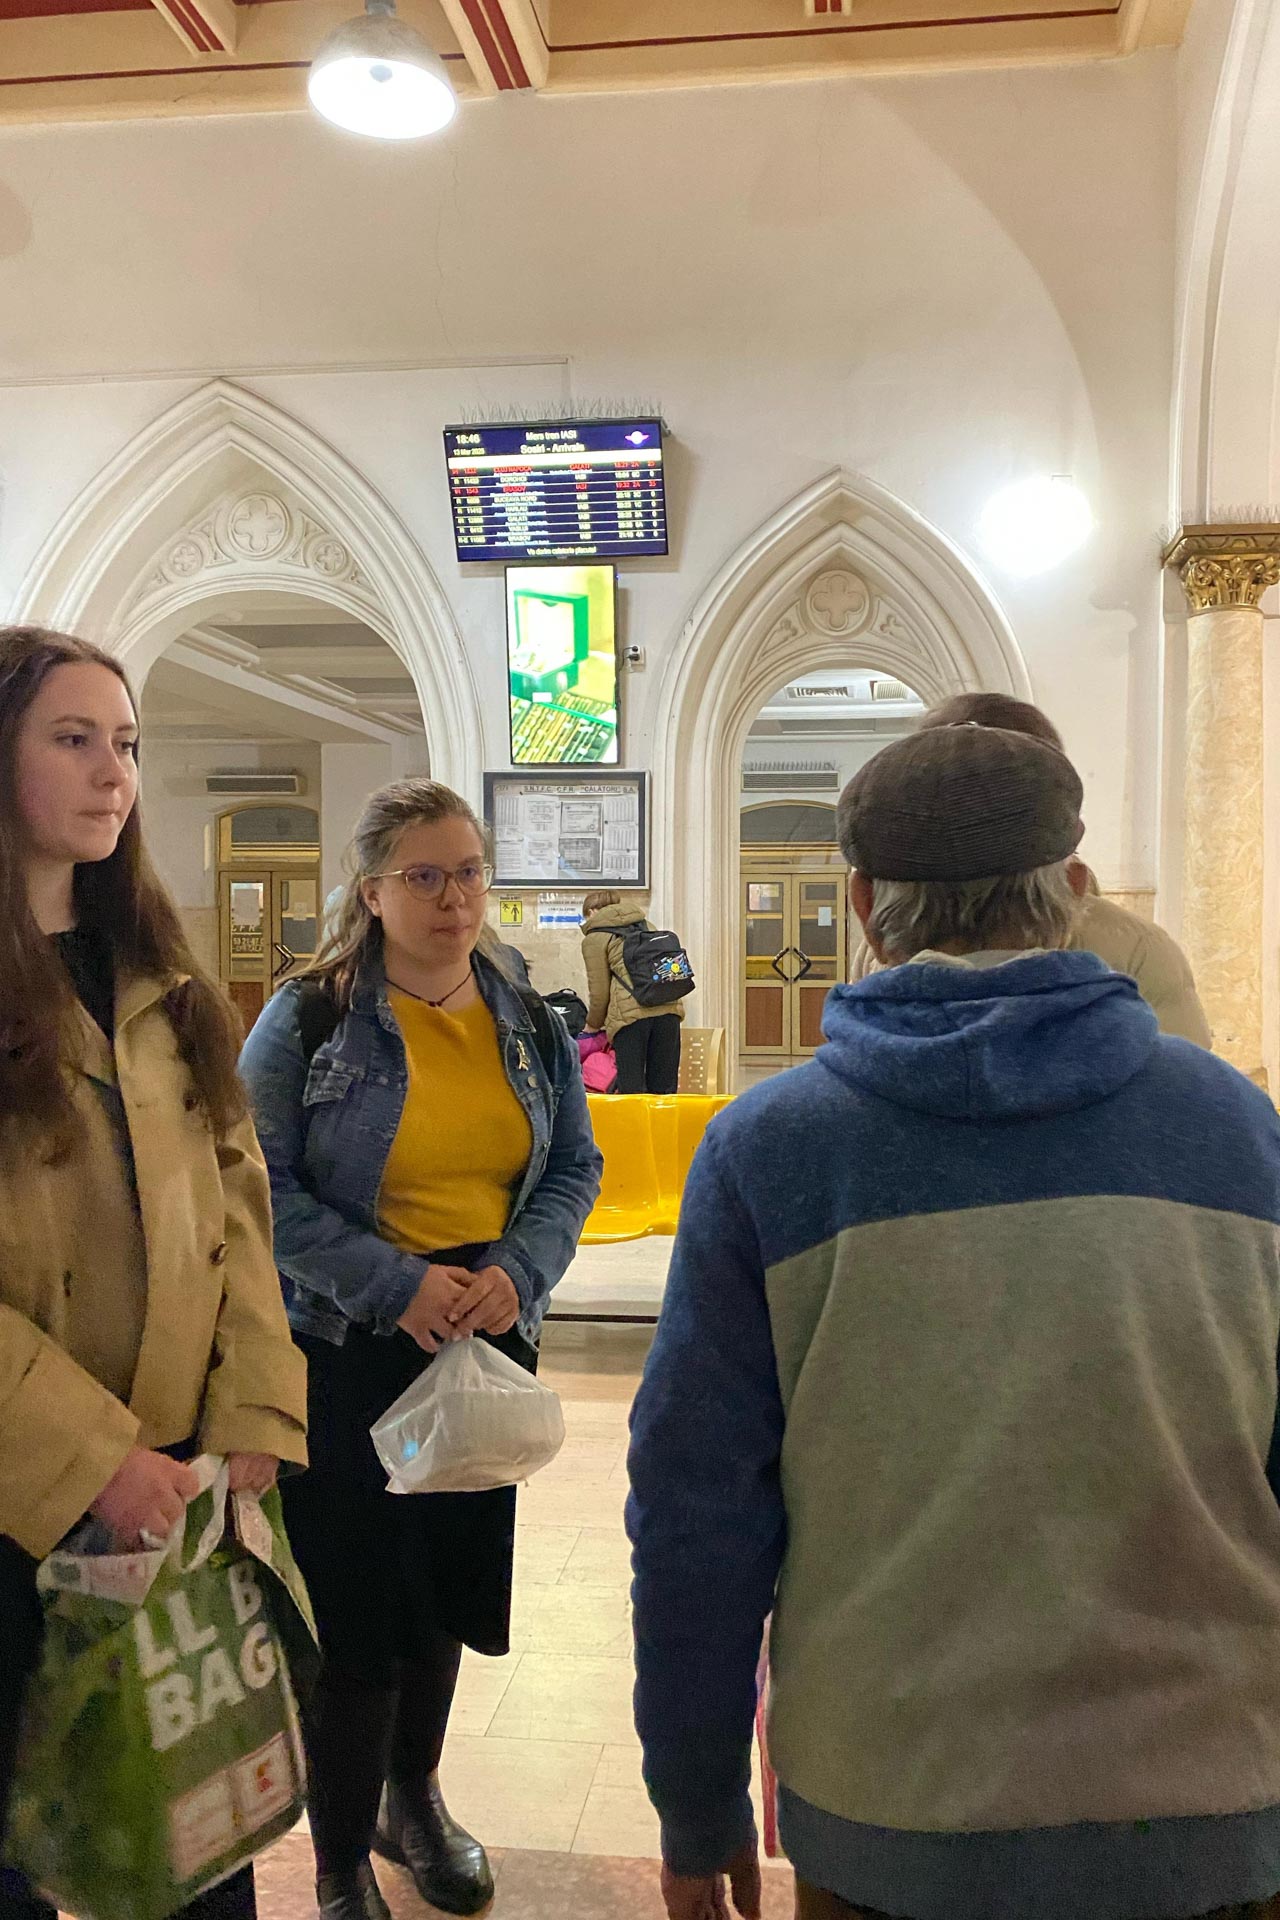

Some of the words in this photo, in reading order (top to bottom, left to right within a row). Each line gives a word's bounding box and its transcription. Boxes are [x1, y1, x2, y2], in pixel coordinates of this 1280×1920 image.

[545, 432, 560, 440] tren
[561, 430, 577, 439] IASI
[552, 443, 585, 452] Arrivals
[144, 1622, 278, 1752] BAG
